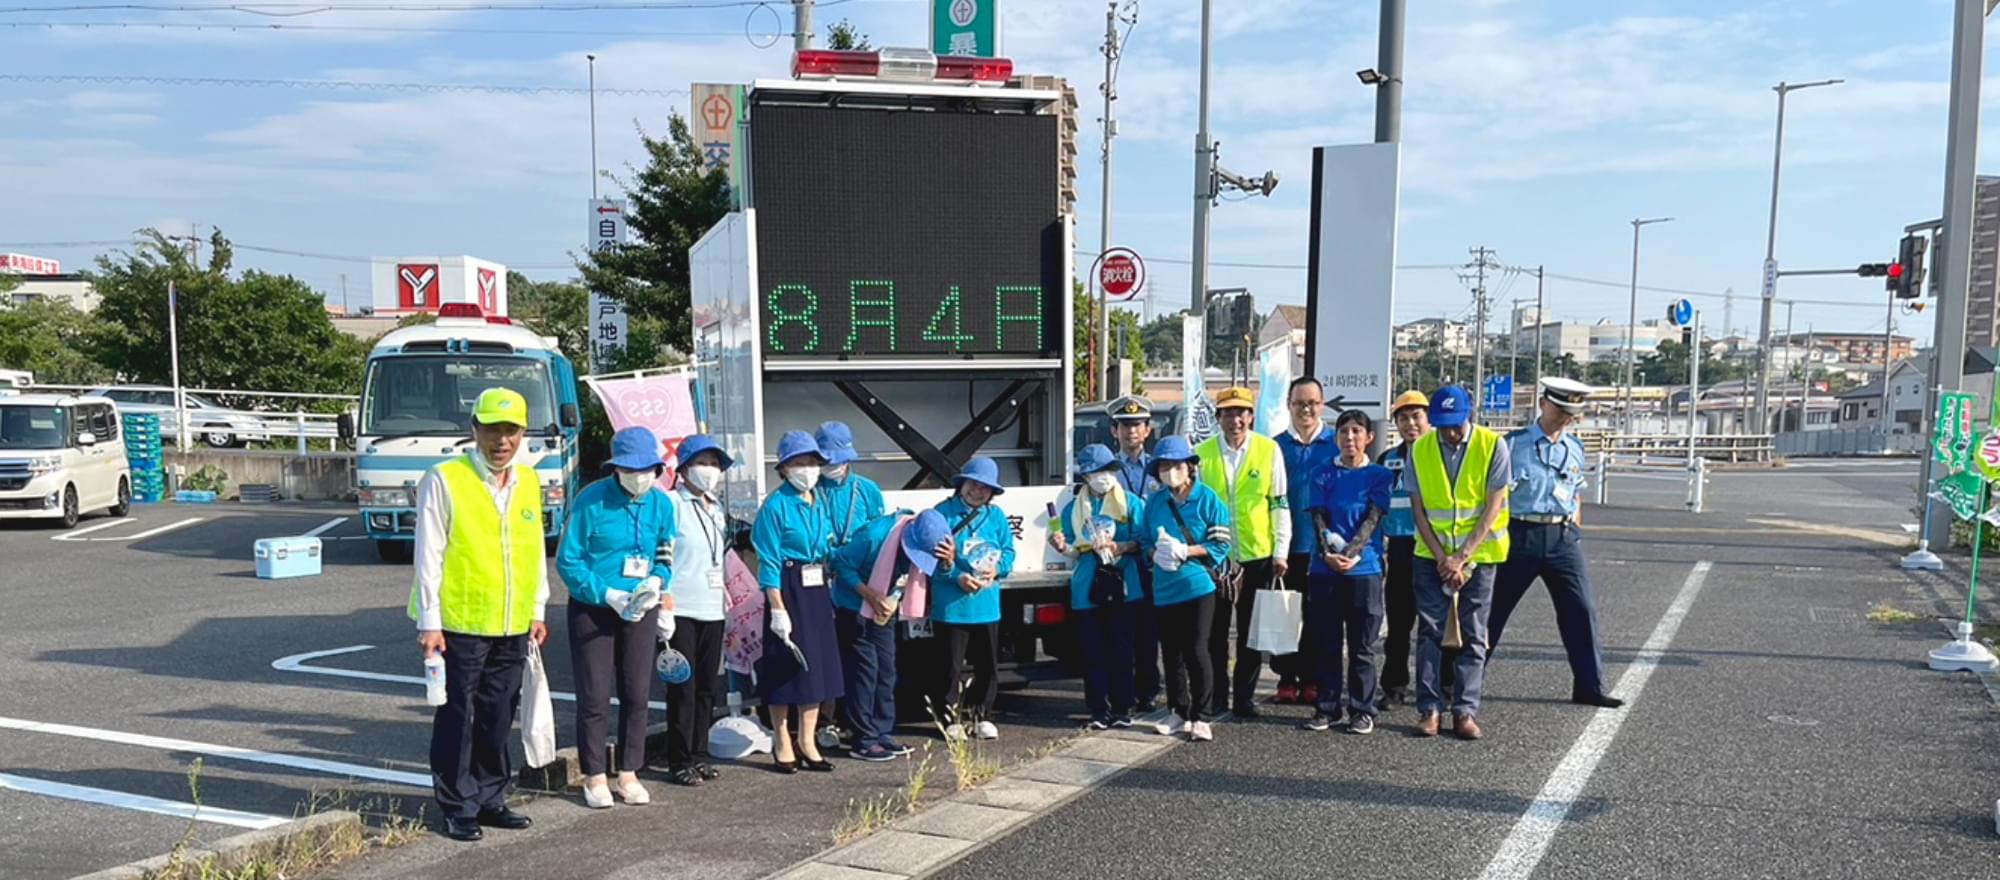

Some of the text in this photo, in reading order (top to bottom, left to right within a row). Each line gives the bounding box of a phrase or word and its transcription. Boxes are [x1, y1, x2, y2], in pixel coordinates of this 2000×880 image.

[400, 267, 436, 305] Y
[479, 271, 495, 310] Y
[1103, 266, 1134, 283] 消火栓
